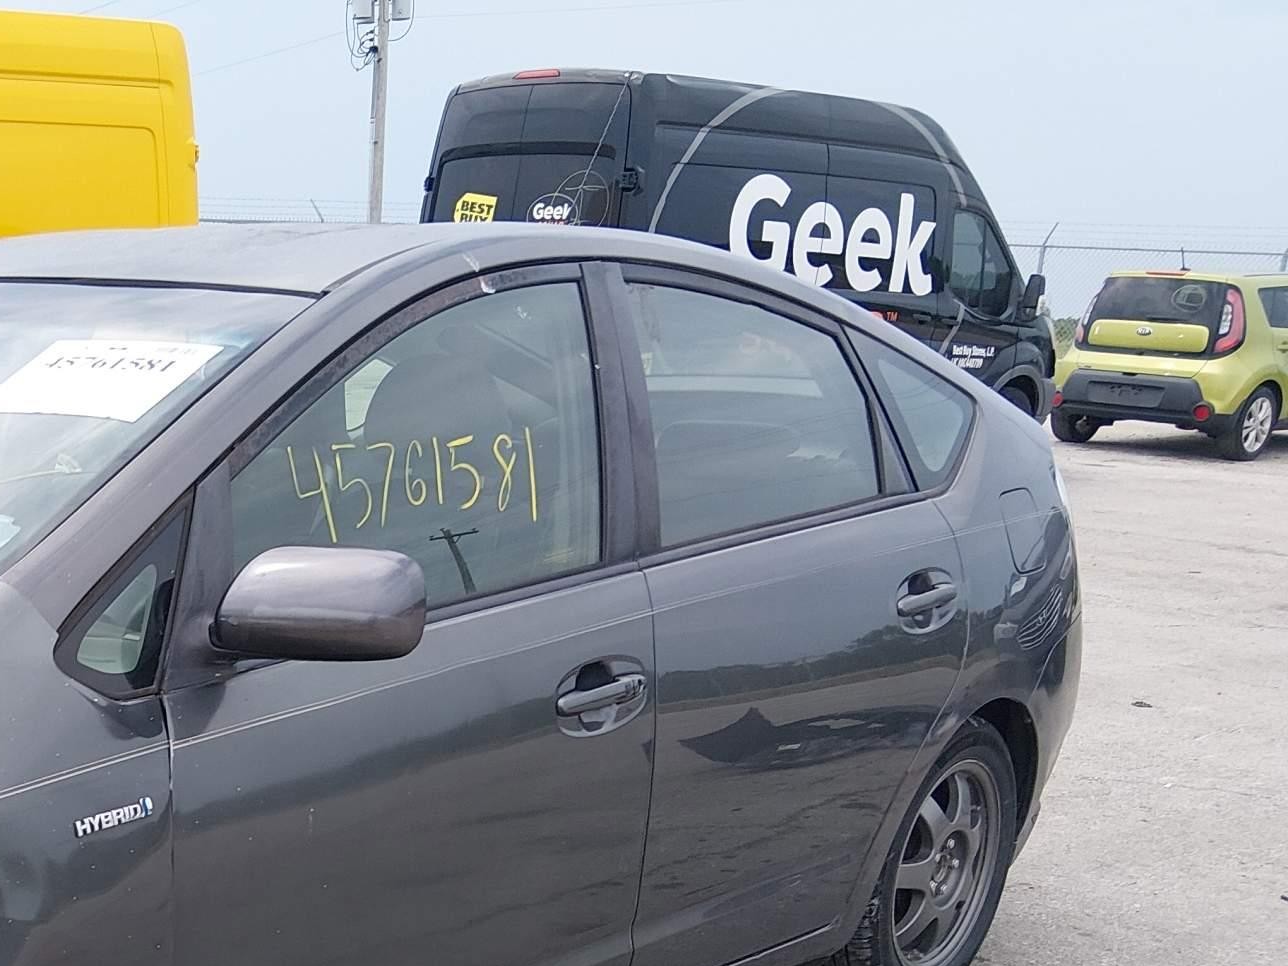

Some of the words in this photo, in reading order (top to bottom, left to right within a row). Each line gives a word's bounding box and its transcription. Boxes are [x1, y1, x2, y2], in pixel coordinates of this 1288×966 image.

[461, 199, 494, 216] BEST
[729, 174, 937, 296] Geek
[886, 311, 898, 321] TM
[952, 344, 963, 355] Best
[287, 426, 538, 543] 45761581
[74, 803, 142, 837] HYBRID
